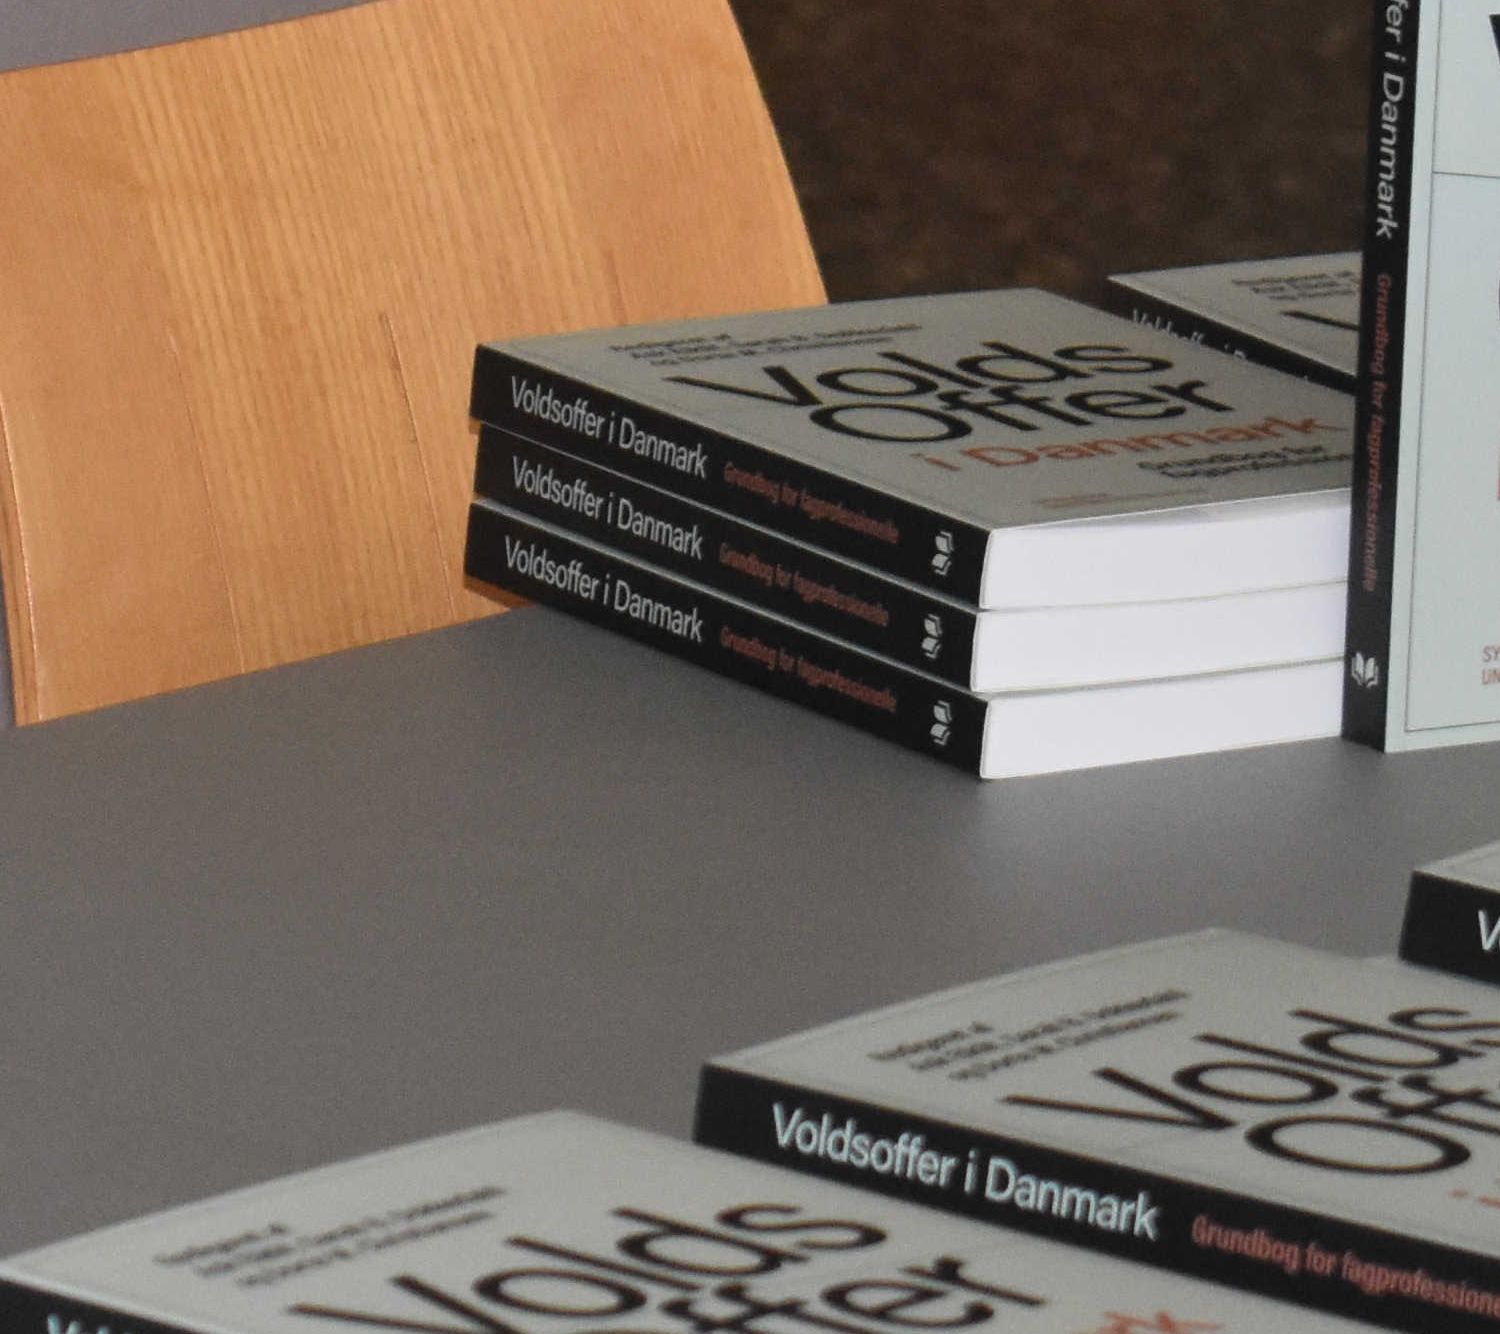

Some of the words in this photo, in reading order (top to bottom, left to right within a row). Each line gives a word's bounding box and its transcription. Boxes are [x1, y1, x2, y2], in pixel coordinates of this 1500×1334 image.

[1384, 50, 1407, 63] i
[1375, 70, 1405, 241] Danmark
[663, 340, 1174, 406] Volds
[808, 378, 1235, 444] Offer
[511, 375, 604, 443] Voldsoffer
[607, 412, 616, 443] i
[619, 417, 709, 480] Danmark
[964, 415, 1344, 469] Danmark
[513, 455, 604, 524] Voldsoffer
[606, 492, 614, 524] i
[617, 497, 704, 561] Danmark
[504, 535, 600, 603] Voldsoffer
[602, 572, 611, 605] i
[614, 577, 704, 644] Danmark
[772, 1101, 958, 1189] Voldsoffer
[963, 1149, 977, 1192] i
[984, 1158, 1160, 1242] Danmark
